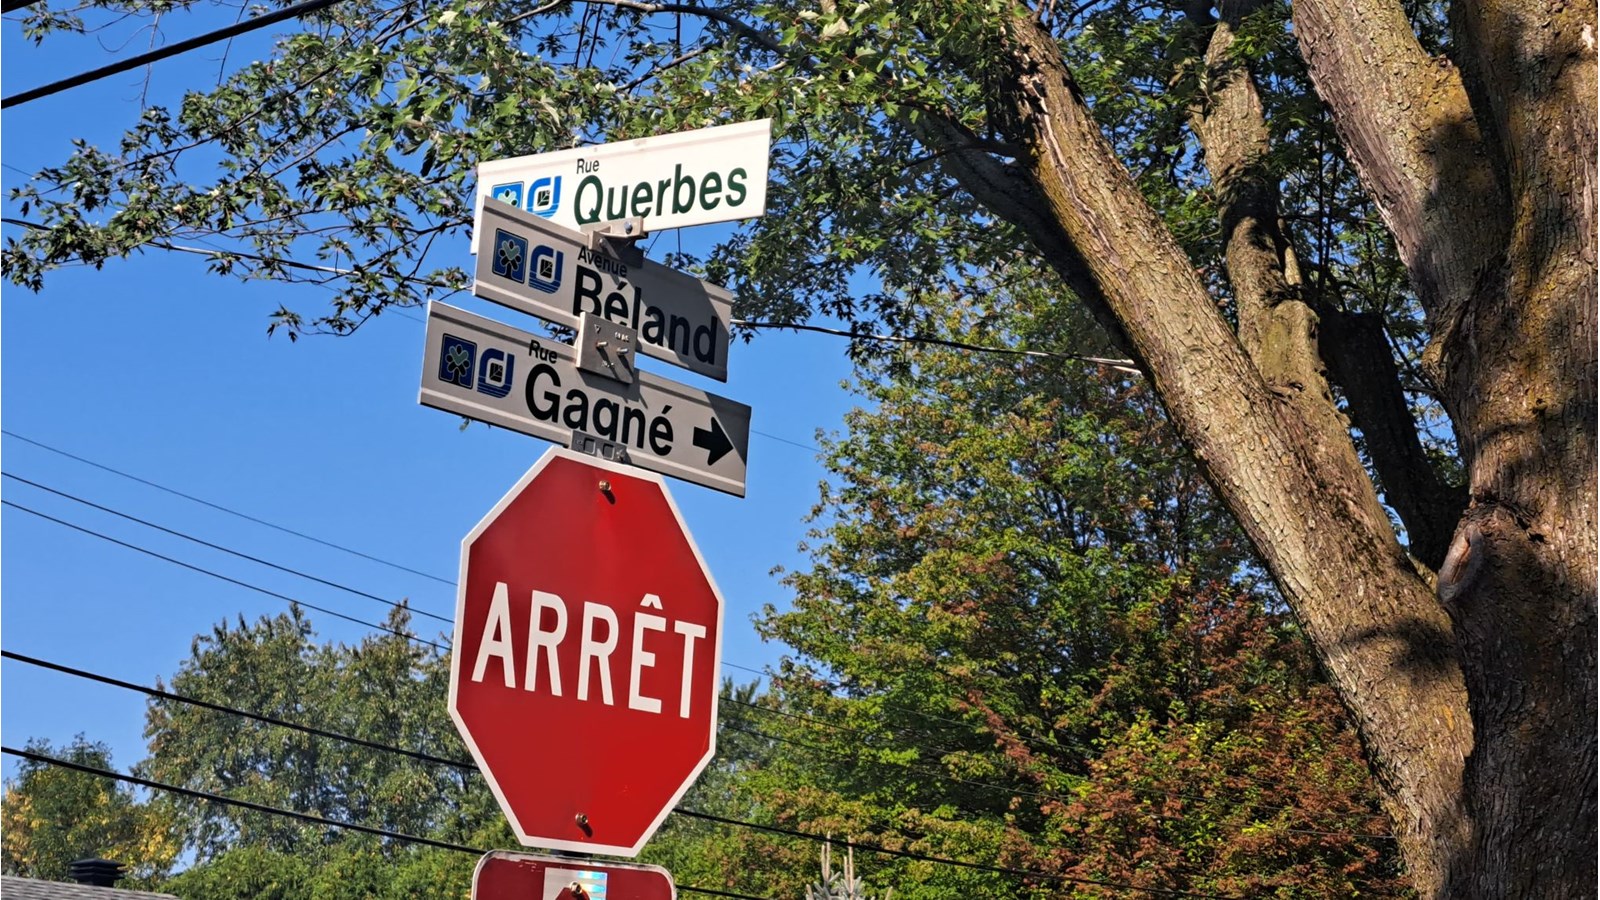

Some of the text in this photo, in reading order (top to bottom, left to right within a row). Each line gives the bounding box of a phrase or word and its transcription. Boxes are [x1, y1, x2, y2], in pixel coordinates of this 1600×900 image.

[573, 163, 748, 226] Querbes
[576, 158, 600, 174] Rue
[577, 245, 628, 278] Avenue
[572, 264, 718, 366] Béland
[528, 339, 558, 364] Rue
[525, 363, 674, 456] Gagné
[471, 581, 707, 719] ARRÊT
